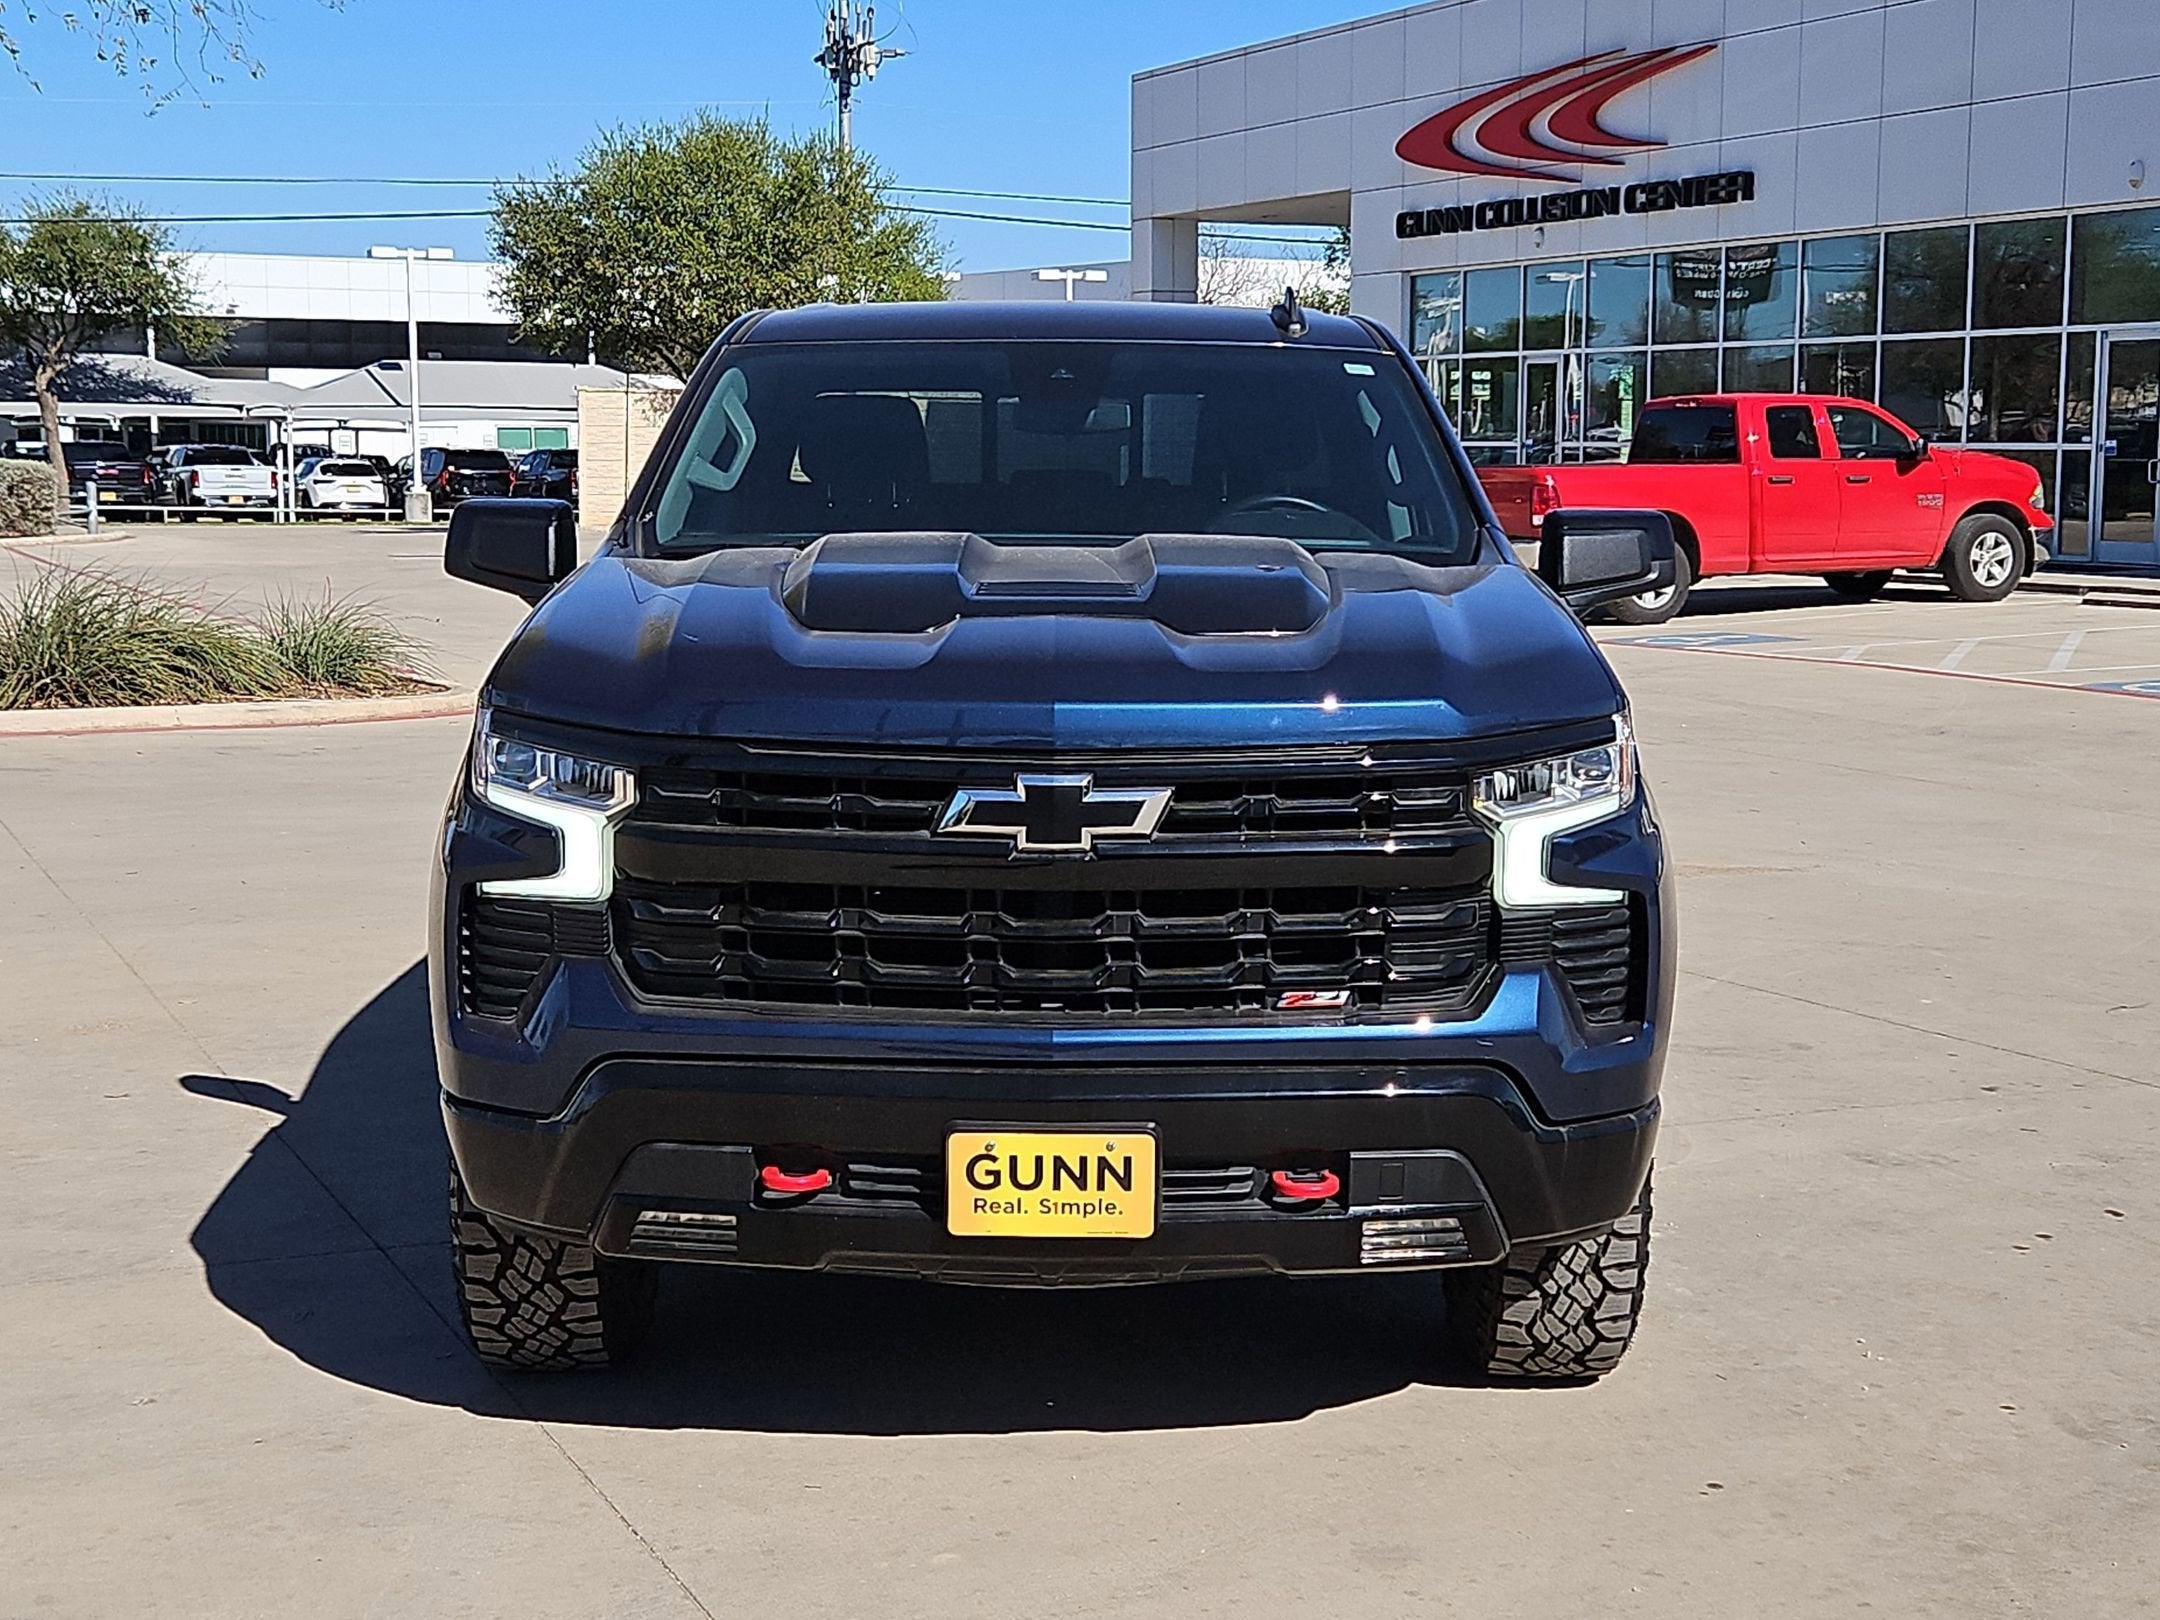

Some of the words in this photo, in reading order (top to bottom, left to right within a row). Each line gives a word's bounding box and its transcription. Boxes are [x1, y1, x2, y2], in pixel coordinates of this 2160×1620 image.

[1396, 204, 1474, 239] GUNN
[1475, 186, 1621, 230] COLLISION
[1623, 170, 1755, 214] CENTER
[1277, 990, 1350, 1008] Z71
[965, 1153, 1133, 1192] GUNN
[973, 1197, 1029, 1215] Real.
